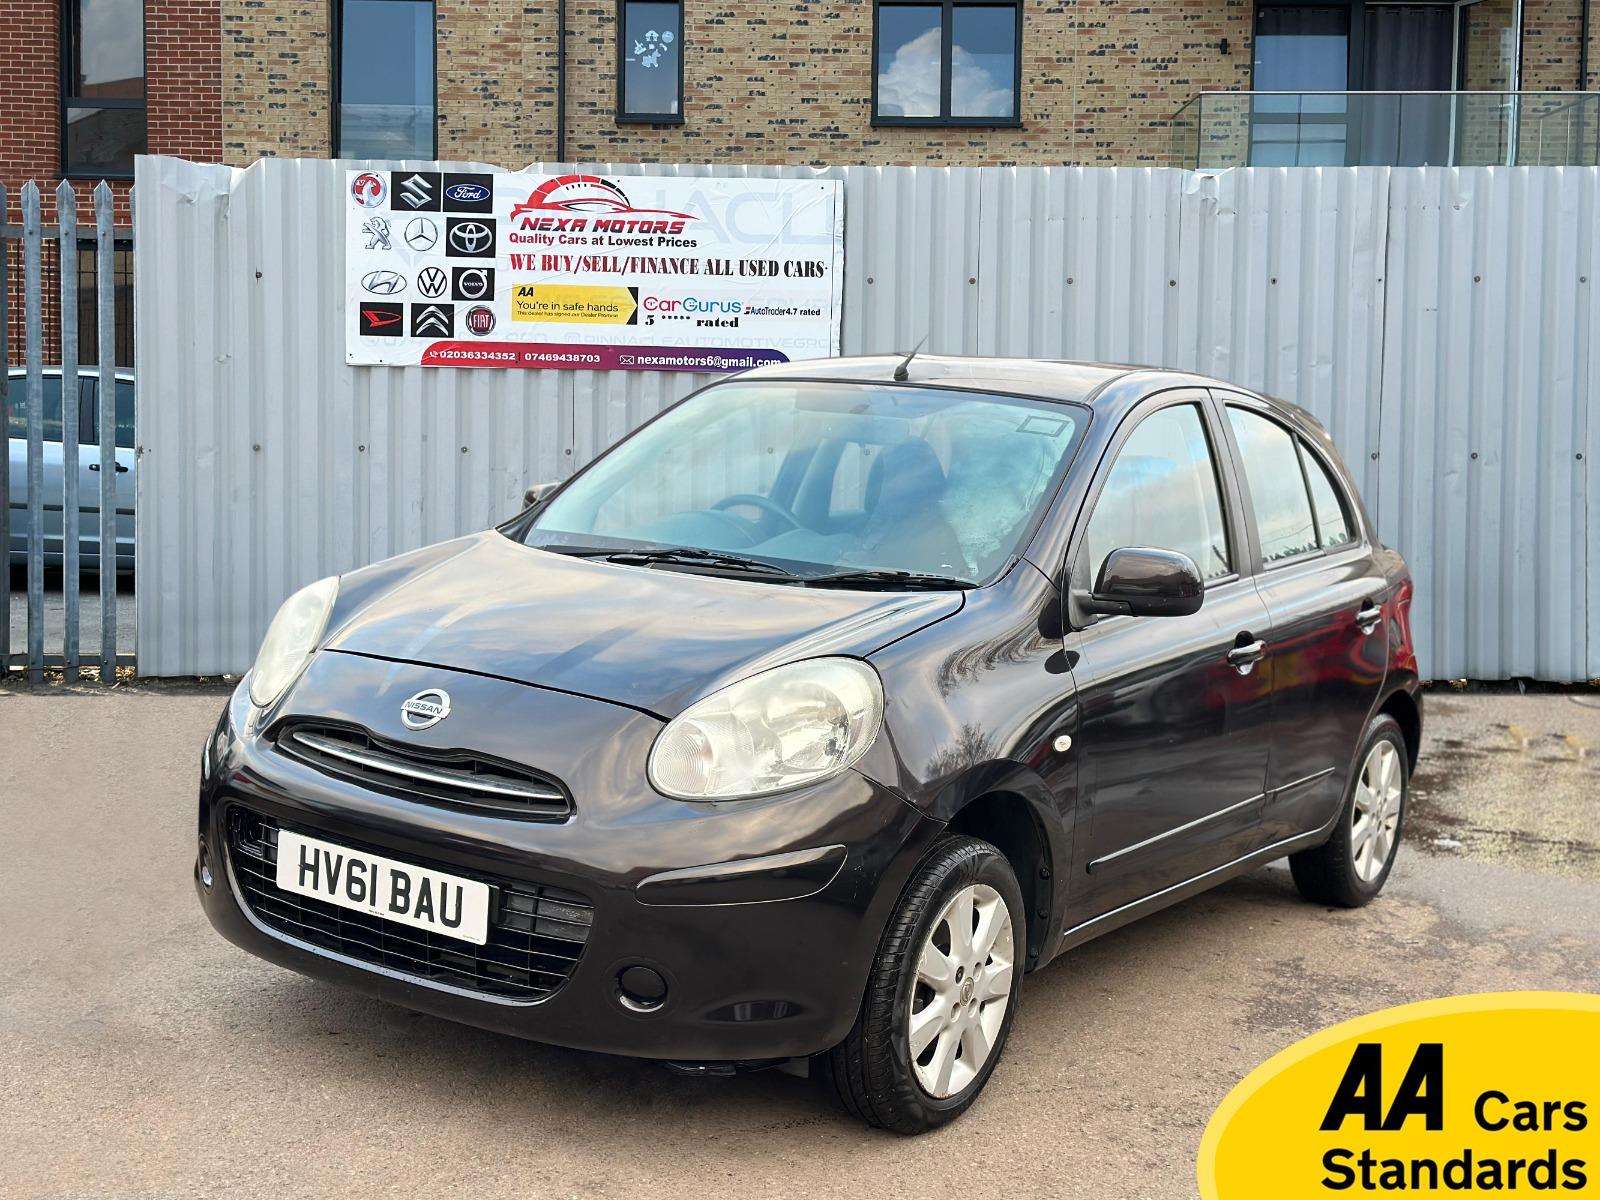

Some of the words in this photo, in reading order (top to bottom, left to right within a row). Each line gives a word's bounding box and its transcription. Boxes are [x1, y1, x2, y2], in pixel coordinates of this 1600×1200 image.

[454, 187, 482, 199] Ford
[520, 217, 588, 232] NEXA
[592, 219, 686, 235] MOTORS
[509, 232, 554, 246] Quality
[558, 234, 588, 245] Cars
[592, 236, 604, 246] at
[608, 236, 653, 246] Lowest
[658, 236, 698, 248] Prices
[510, 254, 536, 270] WE
[542, 254, 699, 275] BUY/SELL/FINANCE
[704, 258, 734, 276] ALL
[739, 259, 780, 277] USED
[784, 260, 824, 278] CARS
[518, 286, 534, 297] AA
[516, 300, 548, 310] You're
[552, 302, 560, 310] in
[562, 302, 584, 312] safe
[587, 302, 618, 312] hands
[643, 296, 742, 313] CarGurus
[474, 314, 490, 328] FIAT
[645, 315, 655, 326] 5
[696, 316, 739, 328] rated
[440, 351, 516, 361] 02036334352
[524, 353, 601, 363] 07469438703
[404, 701, 443, 714] NISSAN
[298, 844, 378, 907] HV61
[388, 868, 464, 929] BAU
